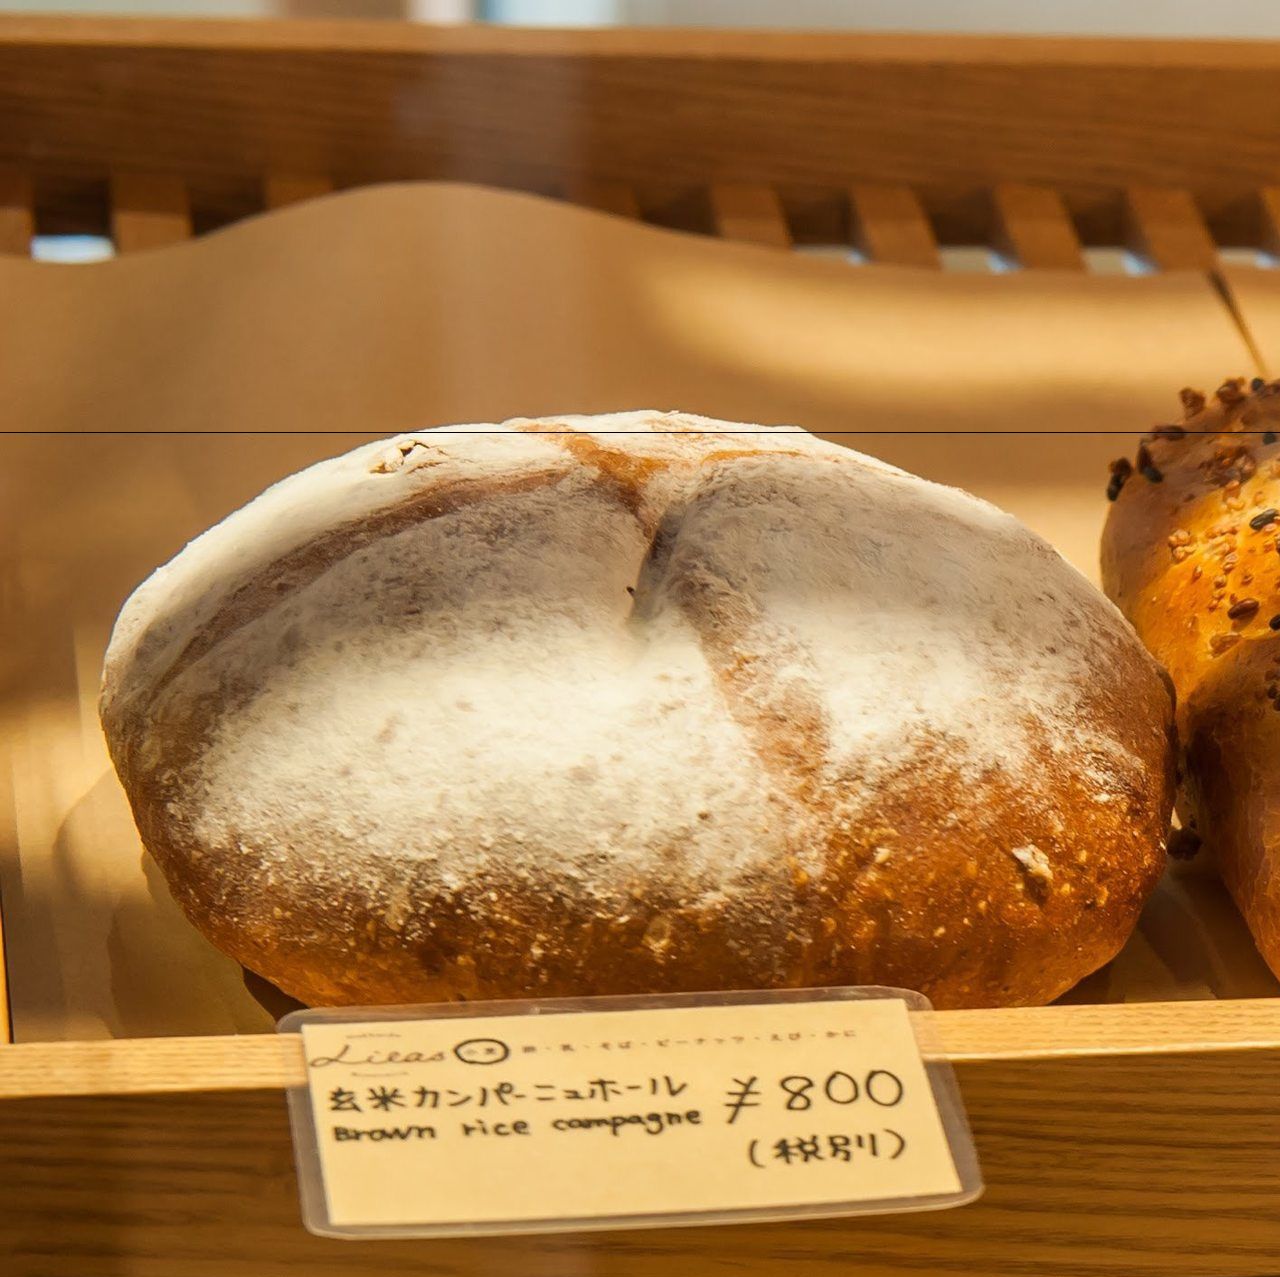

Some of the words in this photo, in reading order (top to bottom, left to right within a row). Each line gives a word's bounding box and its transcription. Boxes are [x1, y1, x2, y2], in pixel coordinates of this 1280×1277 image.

[725, 1070, 904, 1124] ¥800
[333, 1124, 437, 1143] Brown
[462, 1118, 532, 1138] rice
[552, 1109, 702, 1136] campagne
